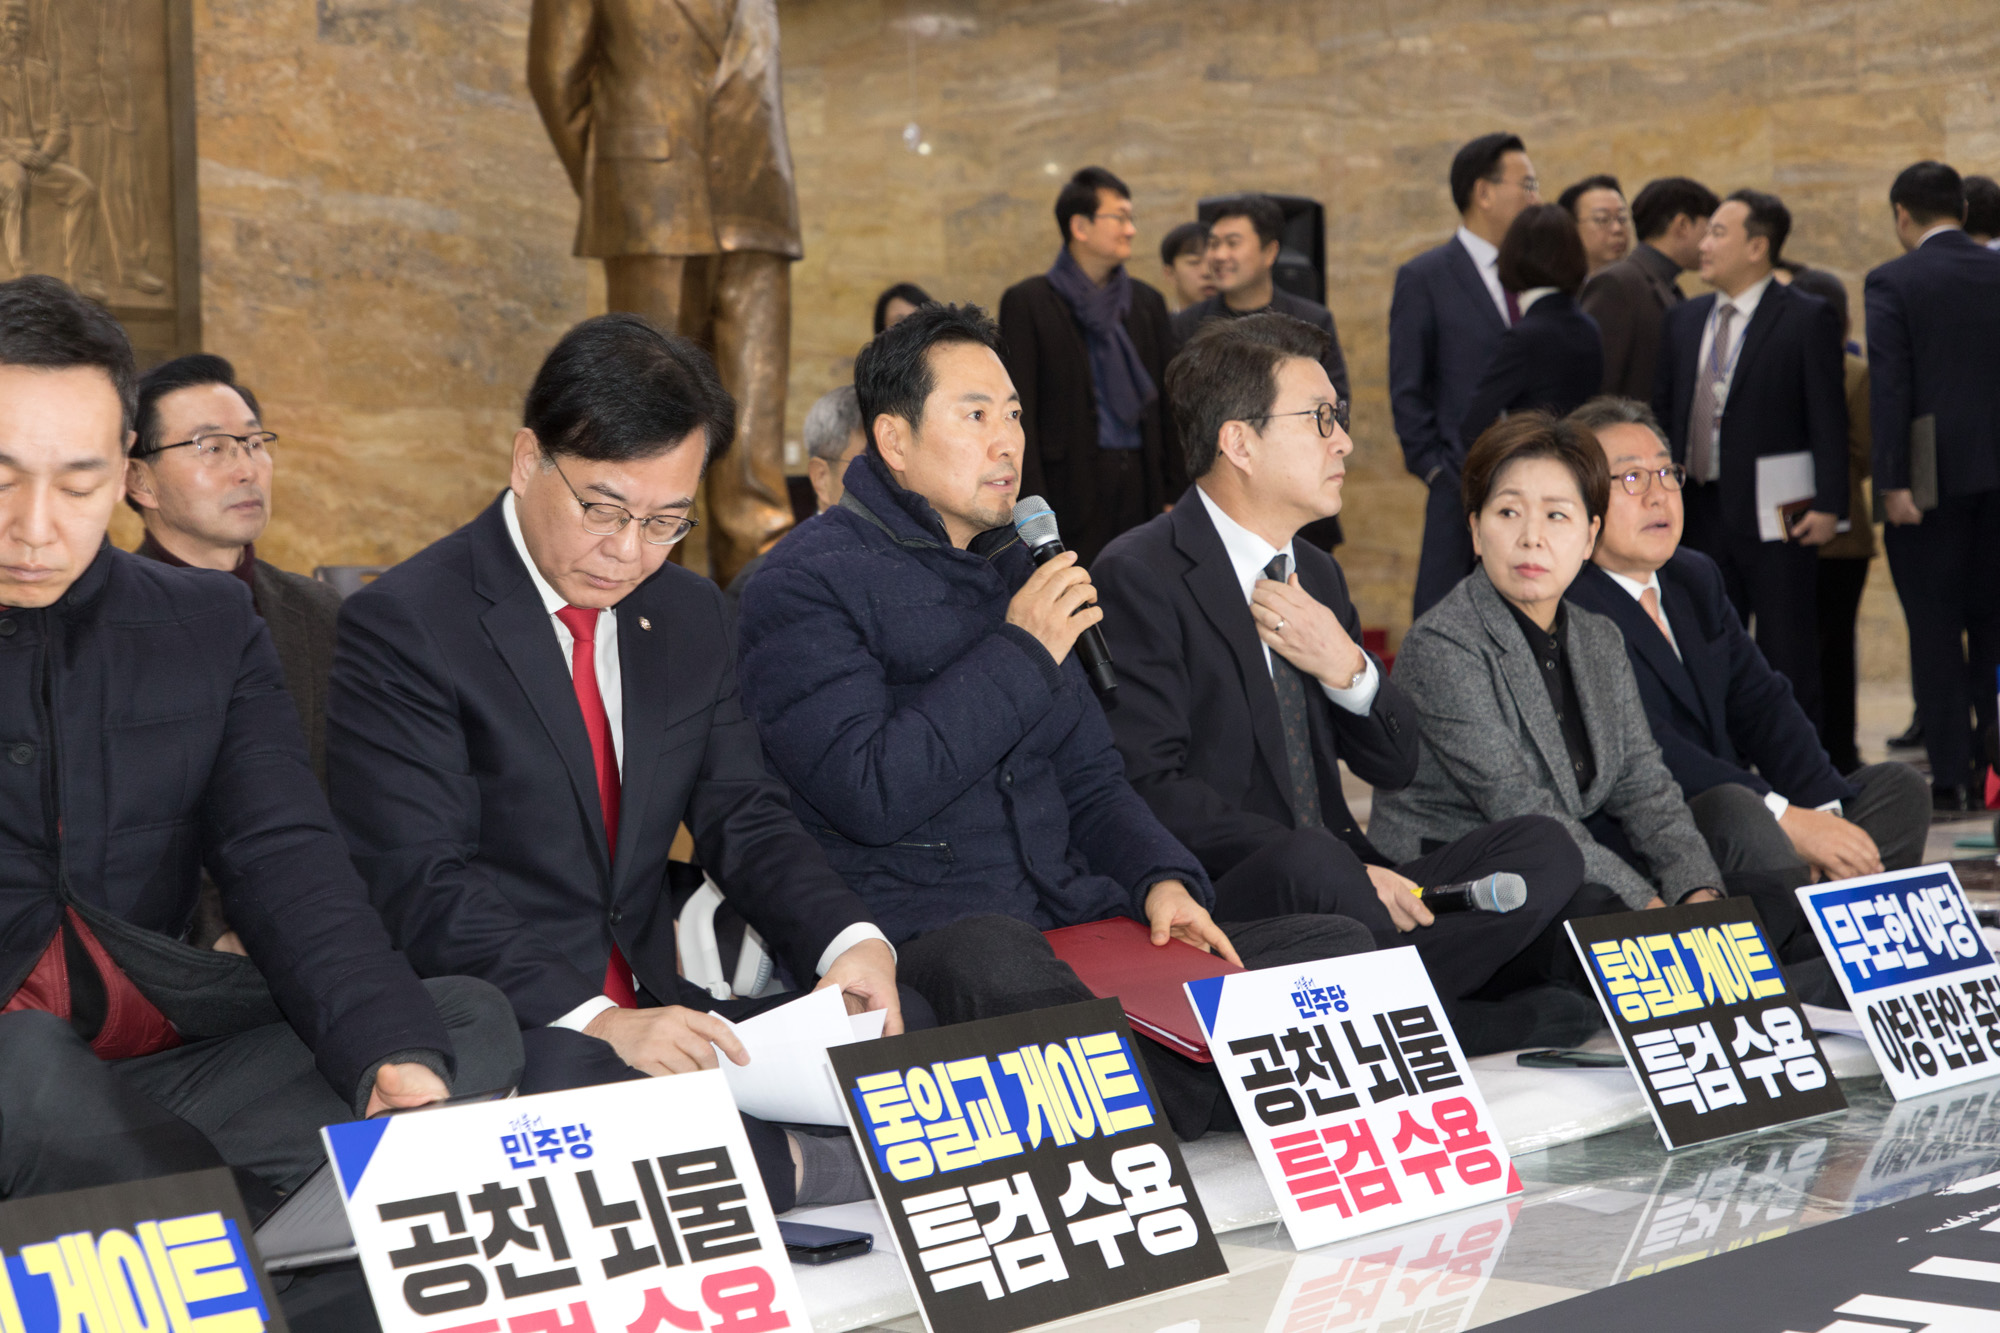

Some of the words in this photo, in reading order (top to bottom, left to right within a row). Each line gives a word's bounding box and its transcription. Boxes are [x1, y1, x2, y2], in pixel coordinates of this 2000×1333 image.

[1590, 933, 1705, 1023] 통일교
[1678, 921, 1786, 1006] 게이트
[1822, 894, 1929, 979] 무도한
[1907, 884, 1979, 960] 여당
[1290, 984, 1349, 1019] 민주당
[856, 1055, 1025, 1182] 통일교
[998, 1031, 1155, 1151] 게이트
[1227, 1026, 1362, 1127] 공천
[1340, 1004, 1464, 1106] 뇌물
[1632, 1021, 1747, 1114] 특검
[1731, 1006, 1827, 1098] 수용
[500, 1123, 593, 1169] 민주당
[1270, 1119, 1403, 1219] 특검
[1390, 1096, 1503, 1195] 수용
[377, 1176, 582, 1316] 공천
[575, 1146, 763, 1280] 뇌물
[901, 1171, 1069, 1300] 특검
[1058, 1143, 1199, 1269] 수용
